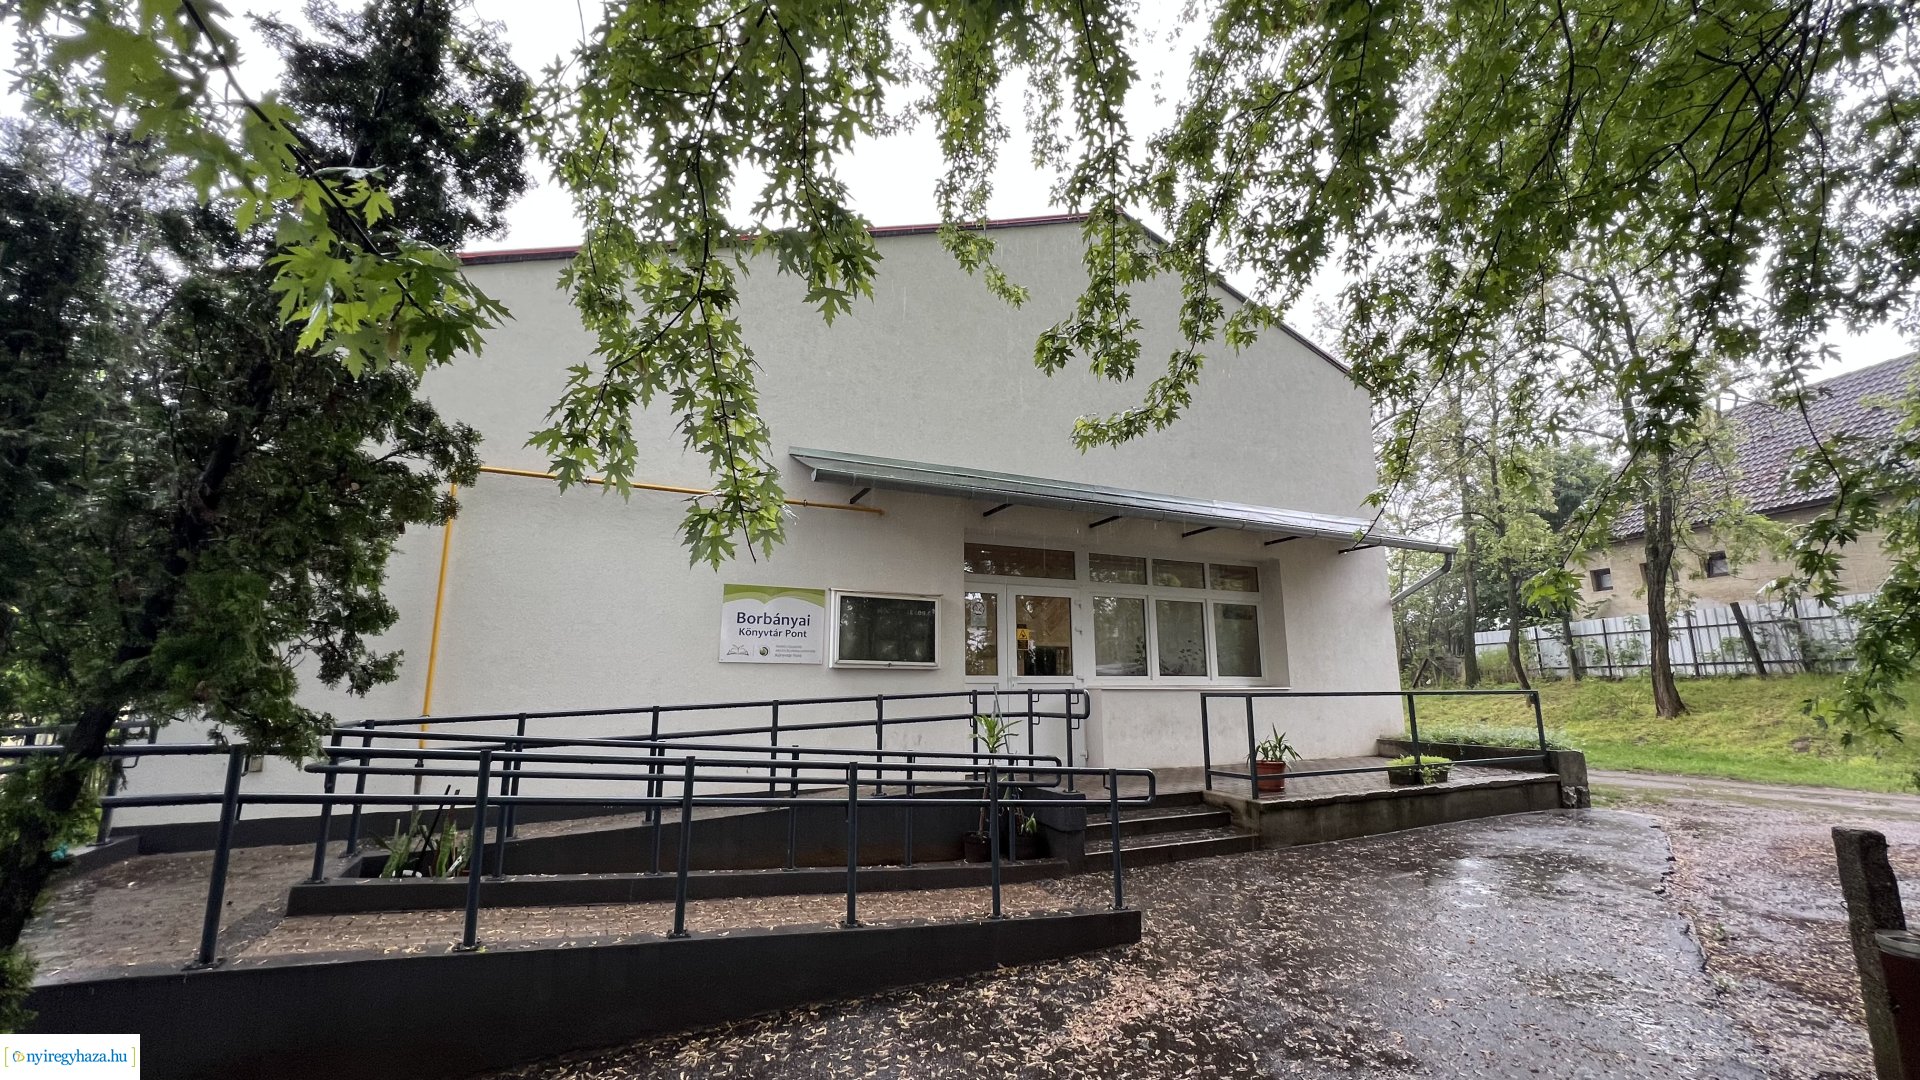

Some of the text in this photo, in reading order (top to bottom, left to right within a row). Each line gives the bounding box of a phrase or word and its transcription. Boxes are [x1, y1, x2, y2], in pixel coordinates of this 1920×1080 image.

[736, 611, 811, 629] Borbányai
[738, 627, 807, 639] Könyvtár Pont
